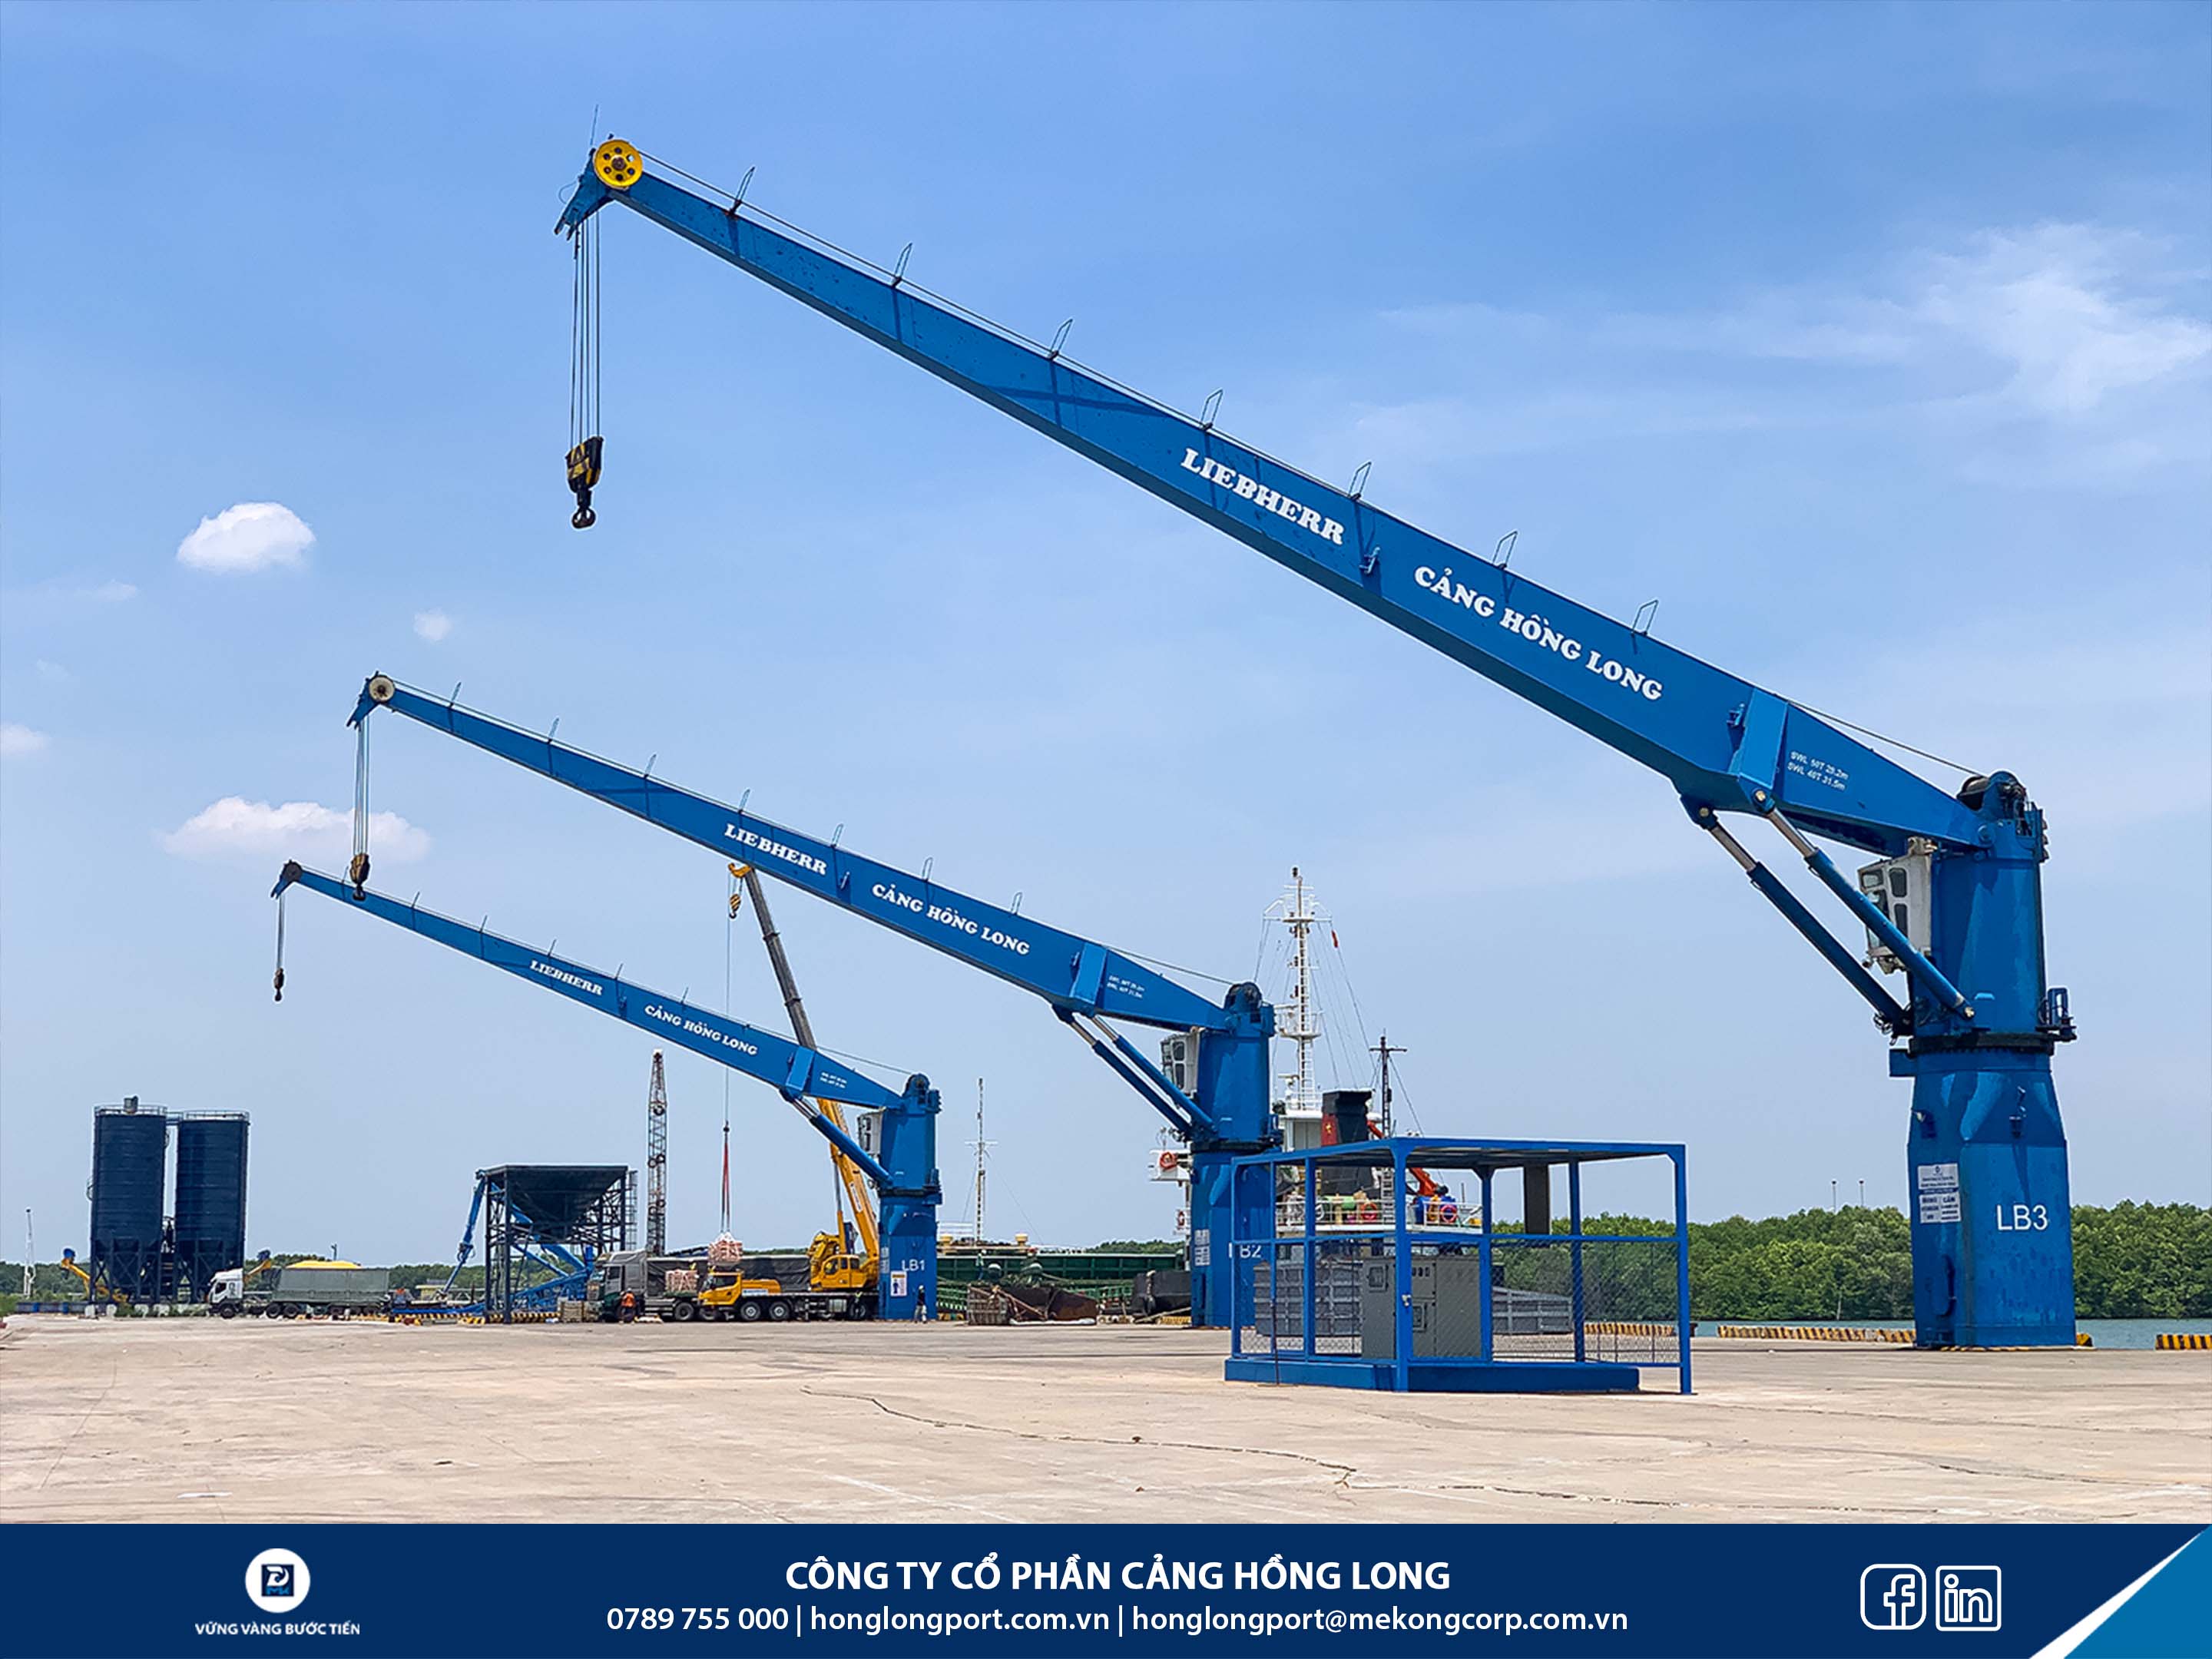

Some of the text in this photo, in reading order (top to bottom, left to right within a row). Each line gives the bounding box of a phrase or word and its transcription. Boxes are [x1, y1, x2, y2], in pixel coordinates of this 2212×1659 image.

[1181, 448, 1344, 545] LIEBHERR
[1415, 568, 1662, 700] CẢNG HỒNG LONG
[724, 823, 827, 876] LIEBHERR
[872, 884, 1030, 955] CẢNG HỒNG LONG
[530, 960, 603, 995] LIEBHERR
[722, 1035, 758, 1055] LONG
[1997, 1204, 2048, 1230] LB3
[902, 1259, 925, 1271] LB1
